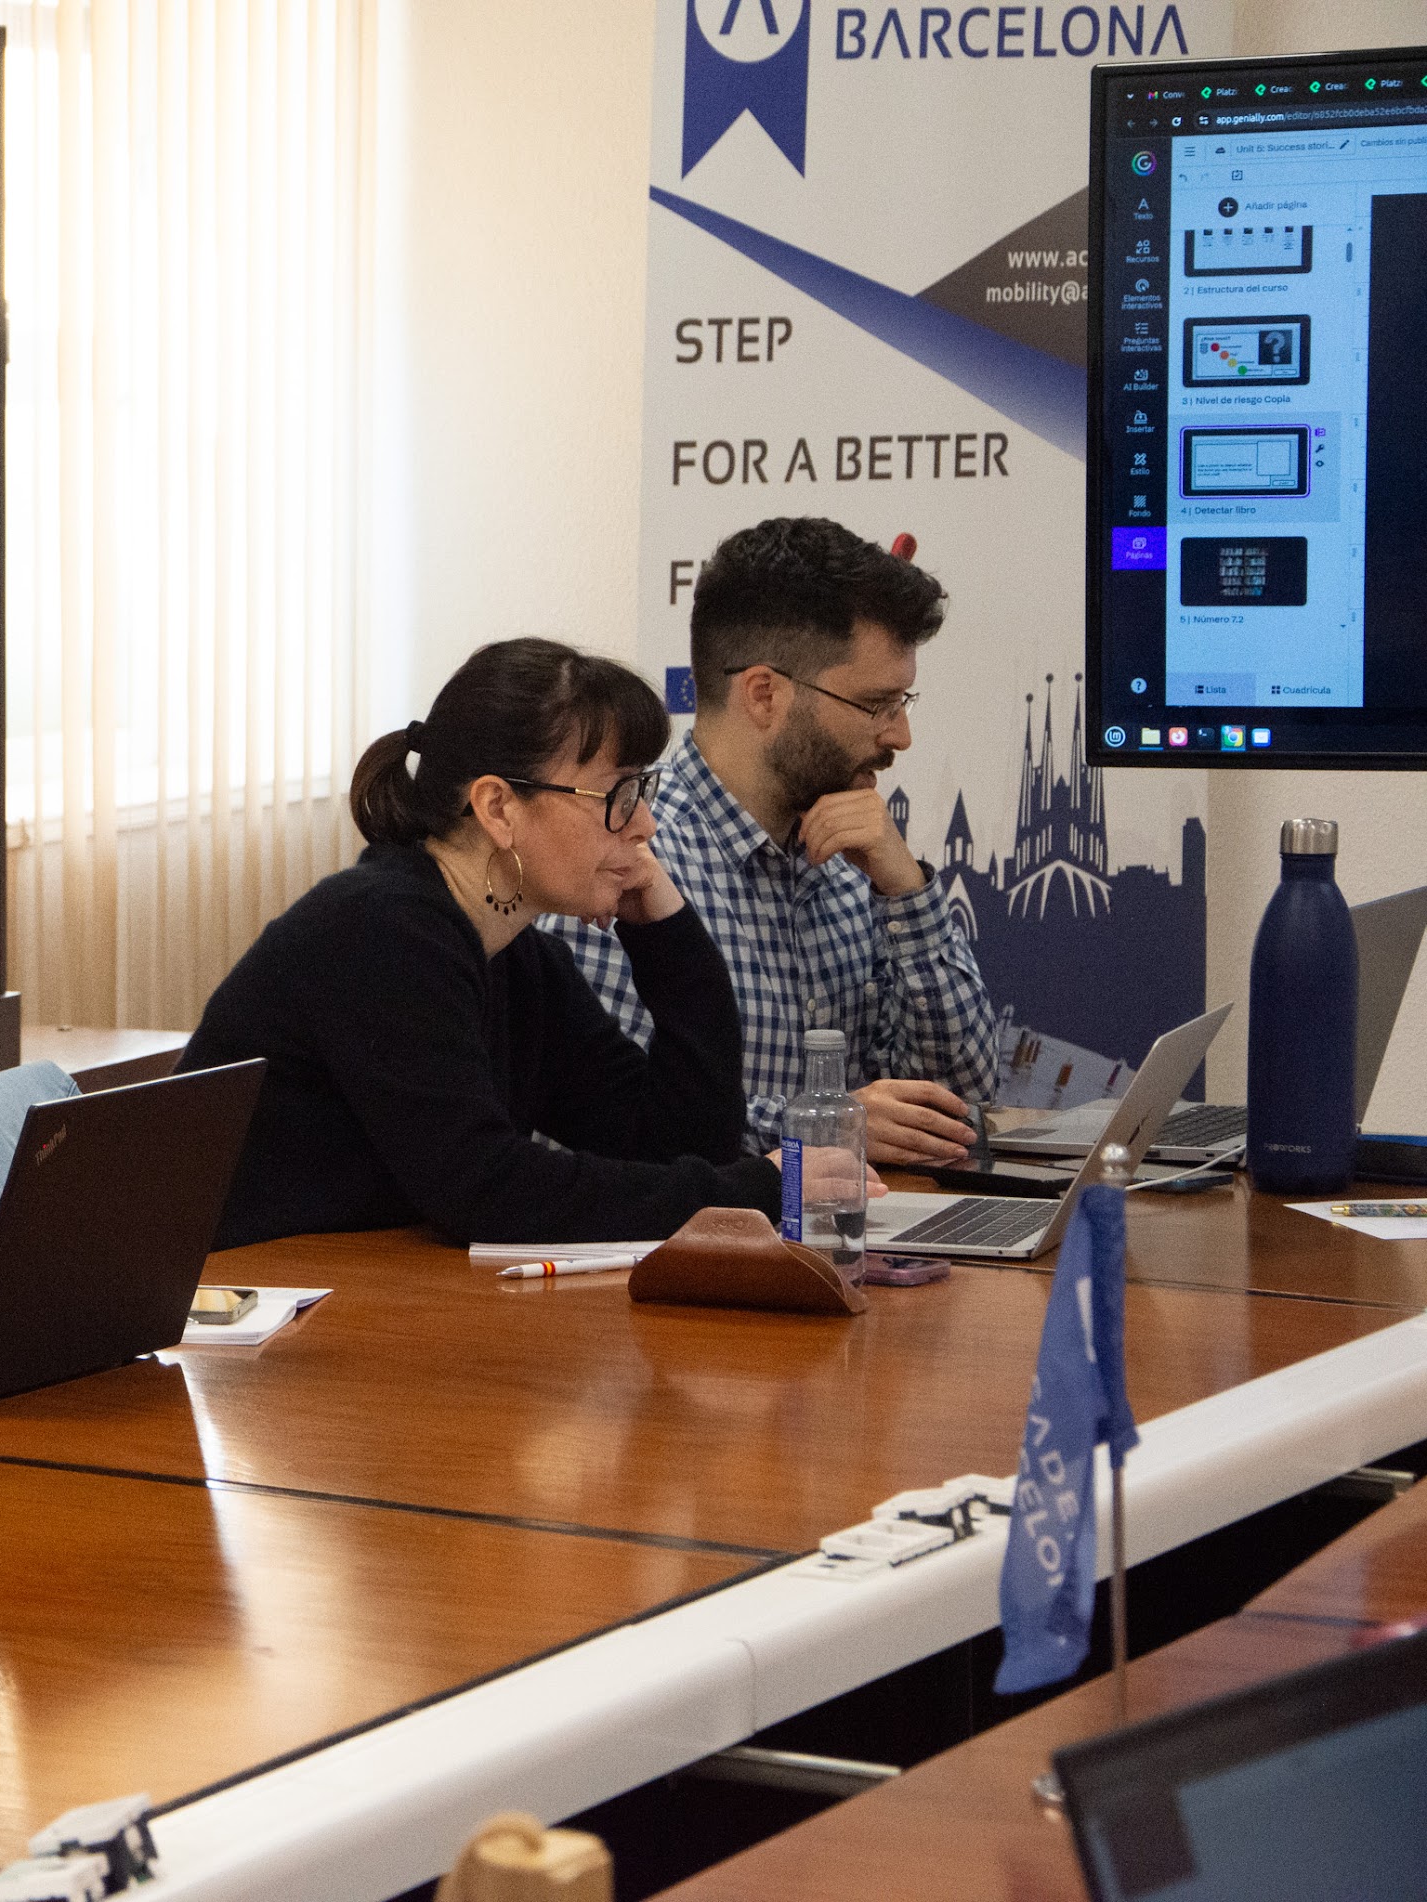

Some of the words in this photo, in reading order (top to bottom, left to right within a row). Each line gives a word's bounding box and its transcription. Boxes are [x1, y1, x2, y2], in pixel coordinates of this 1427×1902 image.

[835, 4, 1190, 60] BARCELONA
[1267, 142, 1306, 152] Success
[1245, 201, 1274, 210] Añadir
[1277, 200, 1308, 211] página
[1197, 286, 1244, 294] Estructura
[1246, 284, 1260, 293] del
[1263, 284, 1288, 293] curso
[1124, 294, 1161, 302] Elementos
[675, 315, 793, 364] STEP
[1124, 337, 1160, 346] Preguntas
[1133, 382, 1159, 391] Builder
[1196, 396, 1219, 405] Nivel
[1221, 396, 1232, 404] de
[1234, 395, 1262, 405] riesgo
[1265, 394, 1291, 404] Copia
[1126, 425, 1155, 433] Insertar
[673, 438, 769, 486] FOR
[784, 437, 817, 483] A
[835, 432, 1010, 482] BETTER
[1130, 467, 1150, 475] Estilo
[1129, 509, 1151, 517] Fondo
[1194, 506, 1234, 515] Detectar
[1235, 506, 1256, 515] libro
[1193, 614, 1230, 624] Número
[1206, 685, 1227, 694] Lista
